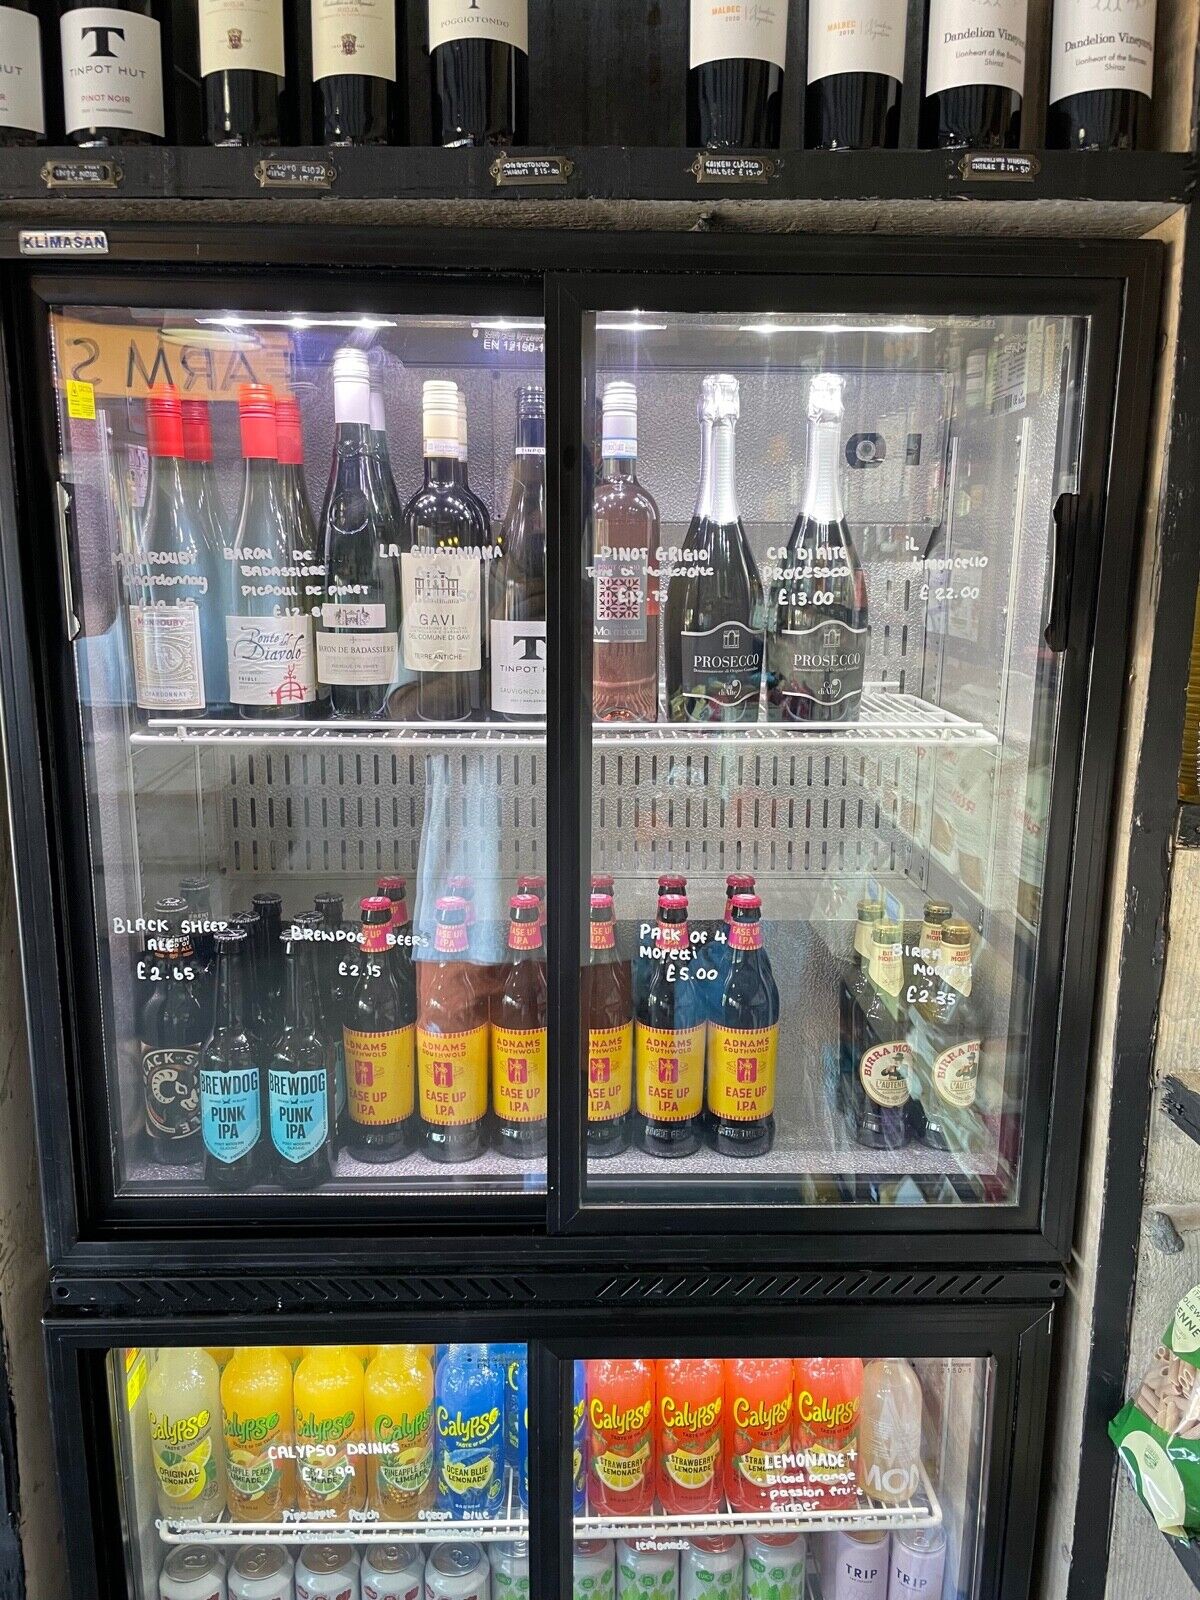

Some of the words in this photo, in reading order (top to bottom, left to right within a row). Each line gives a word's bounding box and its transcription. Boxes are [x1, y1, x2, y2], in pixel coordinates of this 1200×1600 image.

[712, 5, 741, 15] MALBEC
[440, 16, 510, 28] POGGIOTONDO
[827, 20, 856, 32] MALBEC
[944, 27, 995, 43] Dandelion
[81, 27, 125, 58] T
[1064, 33, 1115, 52] Dandelion
[956, 49, 986, 58] Lionheart
[988, 48, 995, 56] of
[1075, 55, 1107, 66] Lionheart
[1109, 53, 1115, 61] of
[985, 58, 1004, 67] Shiraz
[1105, 63, 1125, 71] Shiraz
[69, 65, 112, 77] TINPOT
[118, 67, 146, 78] HUT
[81, 92, 105, 101] PINOT
[108, 94, 131, 103] NOIR
[484, 339, 499, 350] EN
[224, 547, 272, 560] BARON
[293, 550, 313, 560] DE
[380, 544, 399, 557] LA
[601, 546, 648, 562] PINOT
[656, 547, 708, 562] GRIGIO
[767, 547, 788, 560] CA
[241, 585, 298, 596] PICPOUL
[305, 586, 323, 595] DE
[778, 589, 835, 606] £13.00
[420, 614, 455, 625] GAVI
[241, 626, 280, 644] Ponte
[234, 634, 305, 661] Diavolo
[513, 636, 546, 660] T
[693, 653, 759, 668] PROSECCO
[794, 652, 860, 667] PROSECCO
[500, 665, 538, 673] TINPOT
[500, 687, 540, 695] SAUVIGNON
[113, 917, 169, 934] BLACK
[181, 919, 228, 934] SHEEP
[291, 925, 366, 944] BREWDOG
[386, 933, 429, 947] BEERS
[715, 930, 727, 944] 4
[147, 938, 175, 952] ALE
[137, 961, 195, 981] £2.65
[338, 962, 381, 978] £2.15
[666, 963, 718, 982] £5.00
[907, 986, 956, 1005] £2.35
[346, 1041, 387, 1051] ADNAMS
[422, 1041, 467, 1051] ADNAMS
[496, 1038, 541, 1048] ADNAMS
[646, 1037, 692, 1048] ADNAMS
[724, 1037, 770, 1047] ADNAMS
[497, 1047, 540, 1055] SOUTHWOLD
[646, 1046, 691, 1055] SOUTHWOLD
[724, 1046, 769, 1054] SOUTHWOLD
[864, 1048, 891, 1077] BIRRA
[937, 1048, 965, 1080] BIRRA
[201, 1072, 258, 1095] BREWDOG
[270, 1073, 325, 1095] BREWDOG
[372, 1091, 387, 1102] UP
[426, 1089, 450, 1101] EASE
[452, 1091, 467, 1101] UP
[500, 1086, 522, 1099] EASE
[526, 1087, 540, 1099] UP
[588, 1087, 606, 1098] ASE
[608, 1085, 621, 1097] UP
[648, 1086, 673, 1099] EASE
[676, 1087, 690, 1098] UP
[725, 1086, 752, 1098] EASE
[755, 1086, 768, 1098] UP
[211, 1106, 246, 1122] PUNK
[279, 1106, 313, 1122] PUNK
[218, 1124, 238, 1139] IPA
[286, 1124, 306, 1139] IPA
[1176, 1306, 1200, 1338] ENNE
[590, 1398, 651, 1435] Calypso
[661, 1396, 722, 1432] Calypso
[437, 1405, 500, 1441] Calypso
[268, 1443, 336, 1460] CALYPSO
[347, 1442, 400, 1456] DRINKS
[600, 1456, 644, 1469] STRAWBERRY
[671, 1455, 714, 1467] STRAWBERRY
[764, 1452, 845, 1469] LEMONADE
[160, 1467, 200, 1478] ORIGINAL
[385, 1465, 417, 1477] PINEAPPLE
[447, 1465, 470, 1477] OCEAN
[471, 1464, 489, 1476] BLUE
[603, 1467, 641, 1476] LEMONADE
[674, 1464, 712, 1474] LEMONADE
[161, 1476, 199, 1484] LEMONADE
[449, 1474, 486, 1483] LEMONADE
[769, 1486, 825, 1500] passion
[846, 1563, 878, 1579] TRIP
[896, 1568, 927, 1588] TRIP
